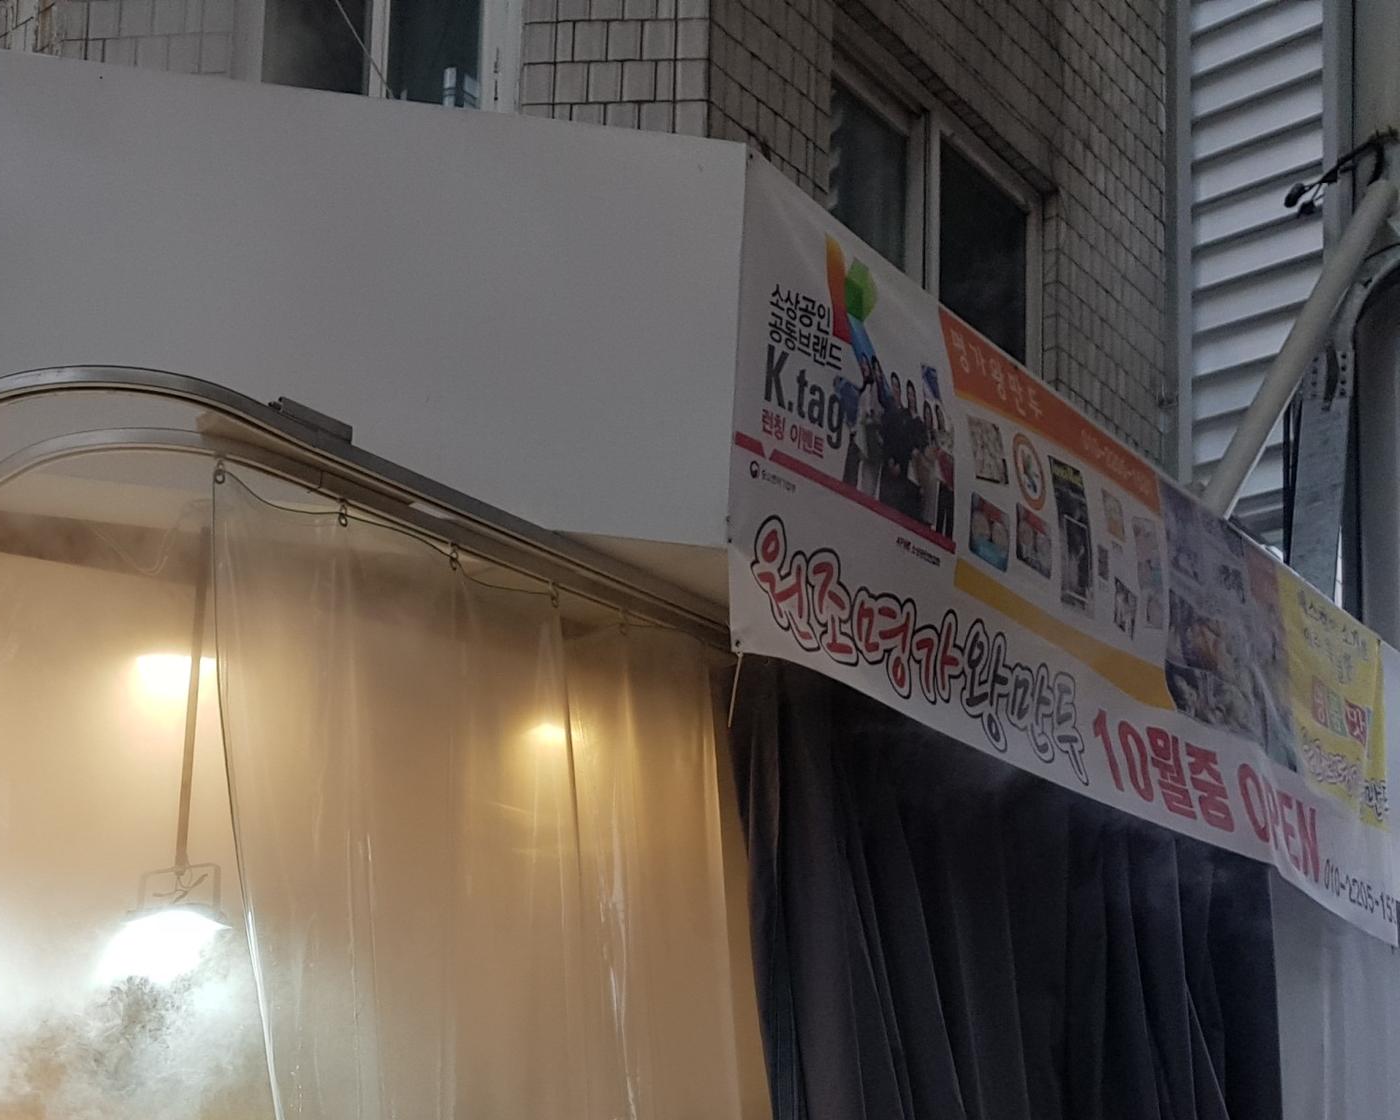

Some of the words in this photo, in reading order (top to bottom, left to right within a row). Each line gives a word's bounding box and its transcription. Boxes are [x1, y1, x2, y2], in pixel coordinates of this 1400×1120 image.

[769, 283, 831, 336] 소상공인
[768, 316, 843, 371] 공동브랜드
[764, 345, 844, 450] K.tag
[760, 407, 786, 441] 런칭
[789, 423, 825, 459] 이벤트
[751, 515, 1089, 786] 원조명가왕만두
[1092, 706, 1235, 833] 10월중
[1237, 763, 1321, 884] OPEN
